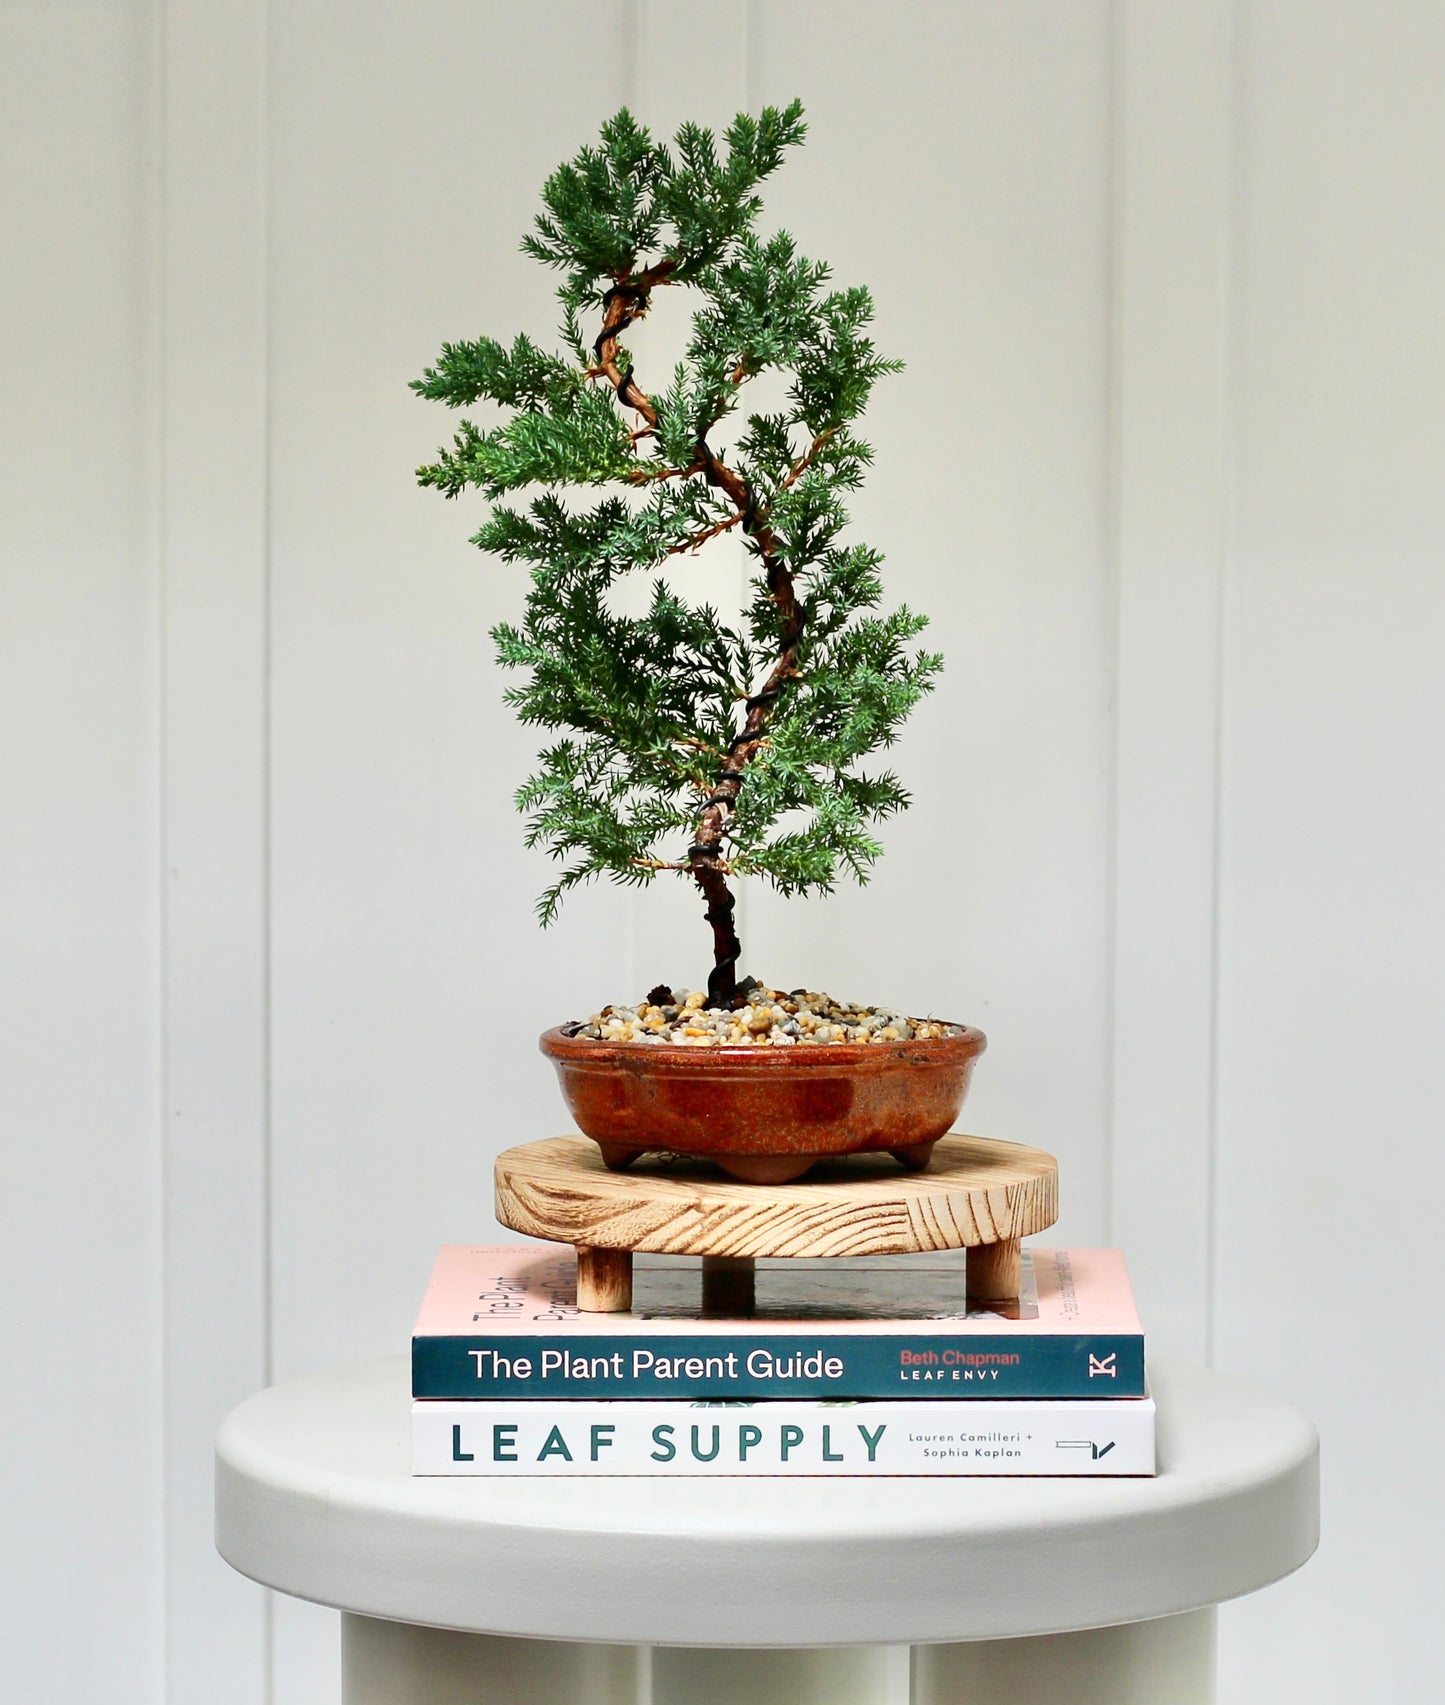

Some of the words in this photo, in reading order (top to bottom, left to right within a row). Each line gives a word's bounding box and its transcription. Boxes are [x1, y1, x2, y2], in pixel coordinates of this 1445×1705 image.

[479, 1276, 531, 1300] Plant
[472, 1302, 524, 1321] The
[468, 1350, 532, 1379] The
[541, 1350, 624, 1379] Plant
[633, 1350, 739, 1379] Parent
[746, 1349, 844, 1379] Guide
[900, 1350, 939, 1366] Beth
[942, 1350, 1020, 1368] Chapman
[900, 1370, 945, 1380] LEAF
[952, 1370, 999, 1380] ENVY
[452, 1424, 616, 1462] LEAF
[649, 1424, 887, 1462] SUPPLY
[909, 1433, 954, 1442] Lauren
[959, 1432, 1020, 1442] Camilleri
[923, 1448, 969, 1459] Sophia
[974, 1448, 1021, 1459] Kaplan
